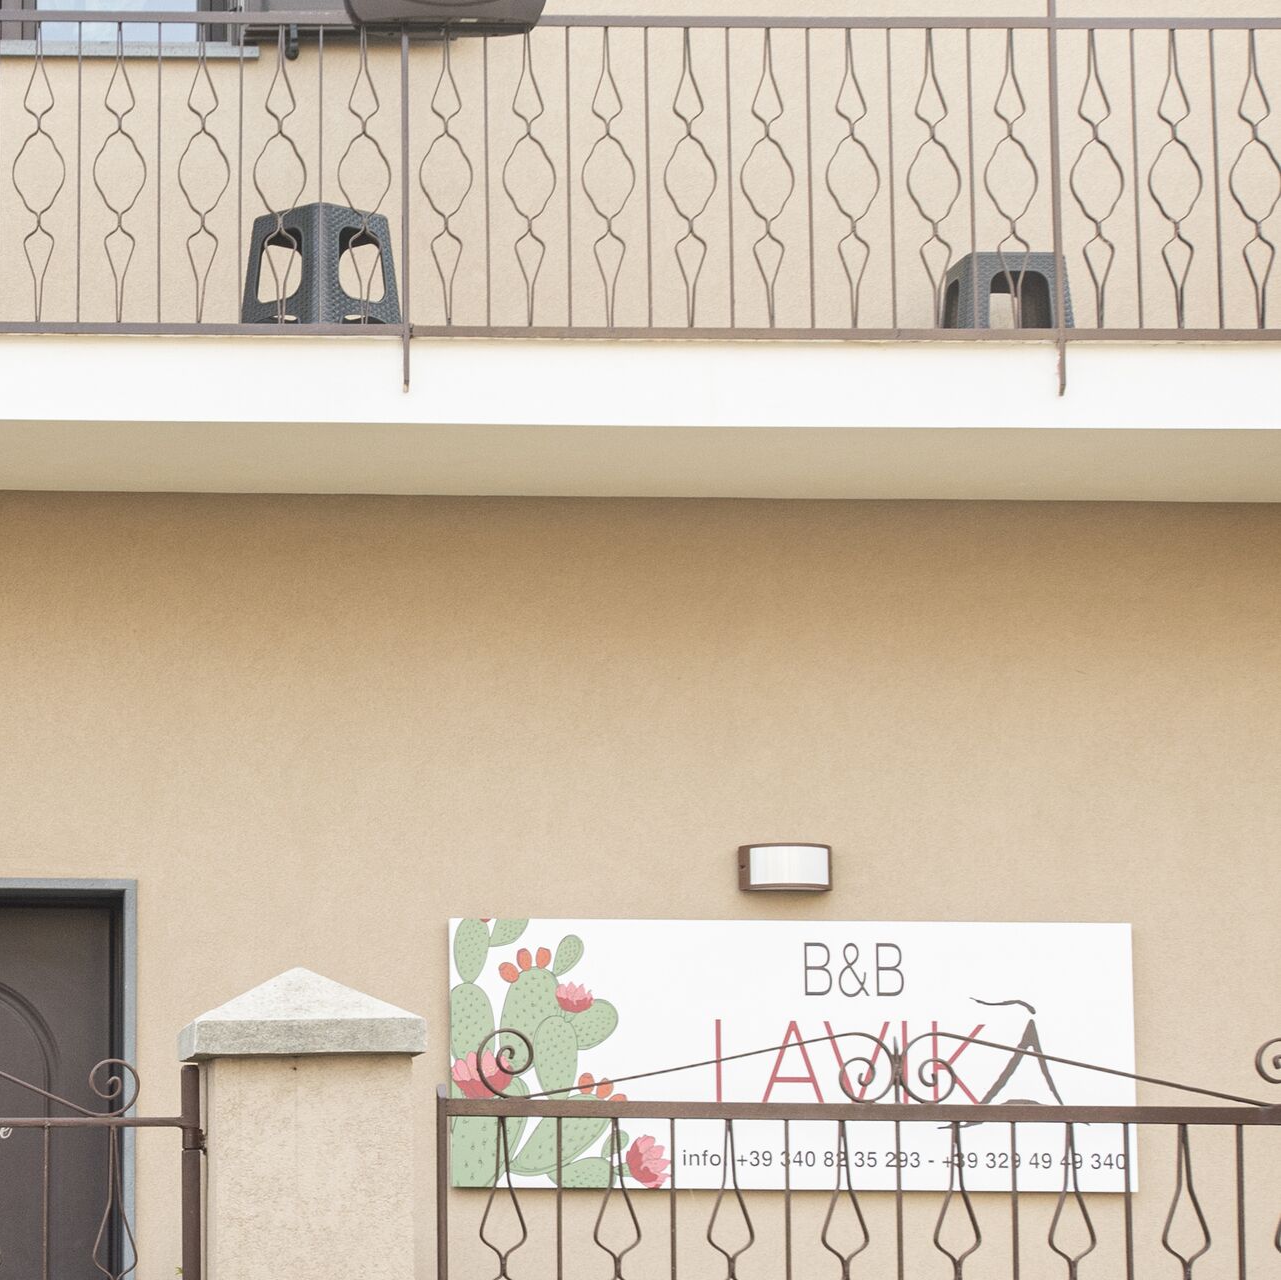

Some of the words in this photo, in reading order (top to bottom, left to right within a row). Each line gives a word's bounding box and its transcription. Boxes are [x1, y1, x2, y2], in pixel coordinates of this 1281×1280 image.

[803, 942, 905, 997] B&B
[736, 1150, 773, 1167] +39
[780, 1150, 816, 1167] 340
[824, 1151, 848, 1167] 82
[854, 1151, 878, 1168] 35
[885, 1151, 920, 1168] 293
[942, 1152, 978, 1169] +39
[986, 1152, 1021, 1169] 329
[1029, 1152, 1052, 1169] 49
[1060, 1153, 1083, 1169] 49
[1091, 1153, 1127, 1170] 340
